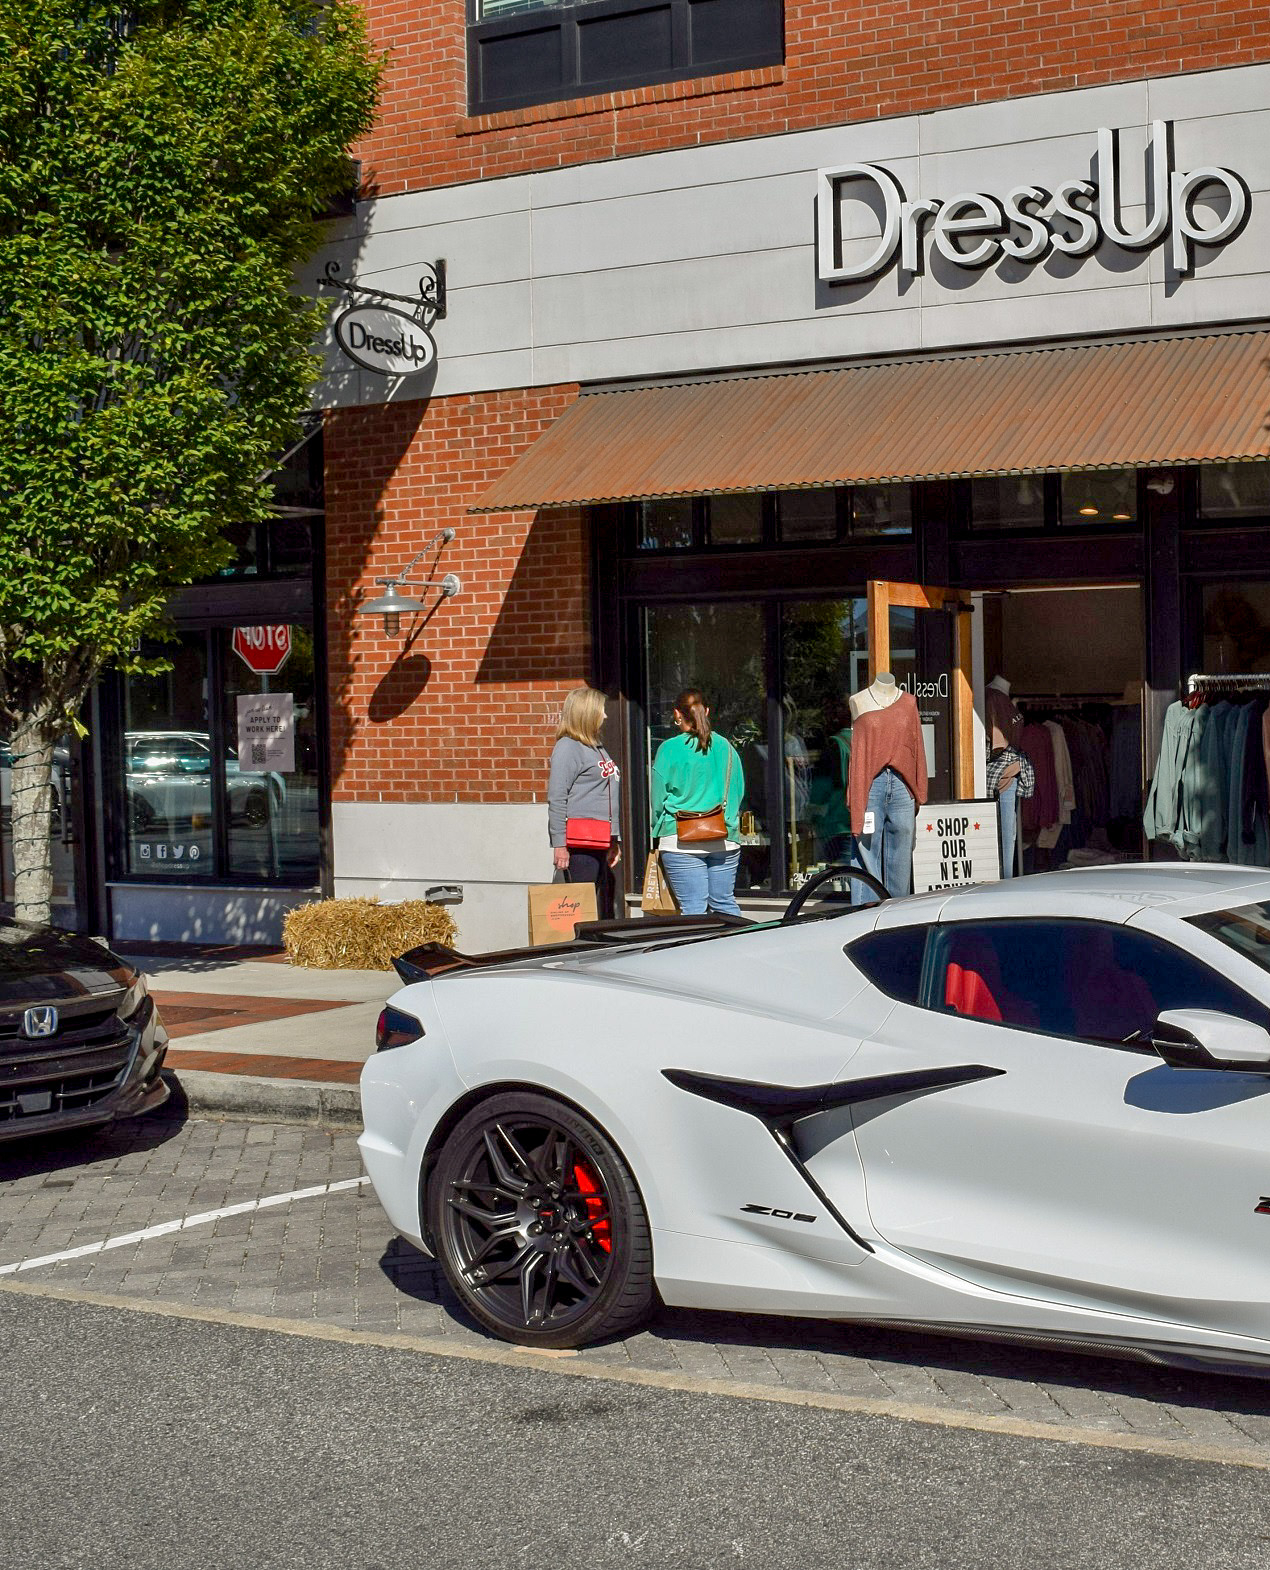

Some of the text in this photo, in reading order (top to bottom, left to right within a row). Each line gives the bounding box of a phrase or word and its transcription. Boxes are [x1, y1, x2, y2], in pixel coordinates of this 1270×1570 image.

[818, 119, 1248, 282] DressUp
[349, 321, 427, 368] DressUp
[246, 725, 265, 733] WORK
[250, 716, 270, 724] APPLY
[937, 817, 969, 837] SHOP
[941, 838, 967, 859] OUR
[646, 860, 658, 900] PRETTY
[940, 860, 973, 881] NEW
[558, 895, 581, 913] shop
